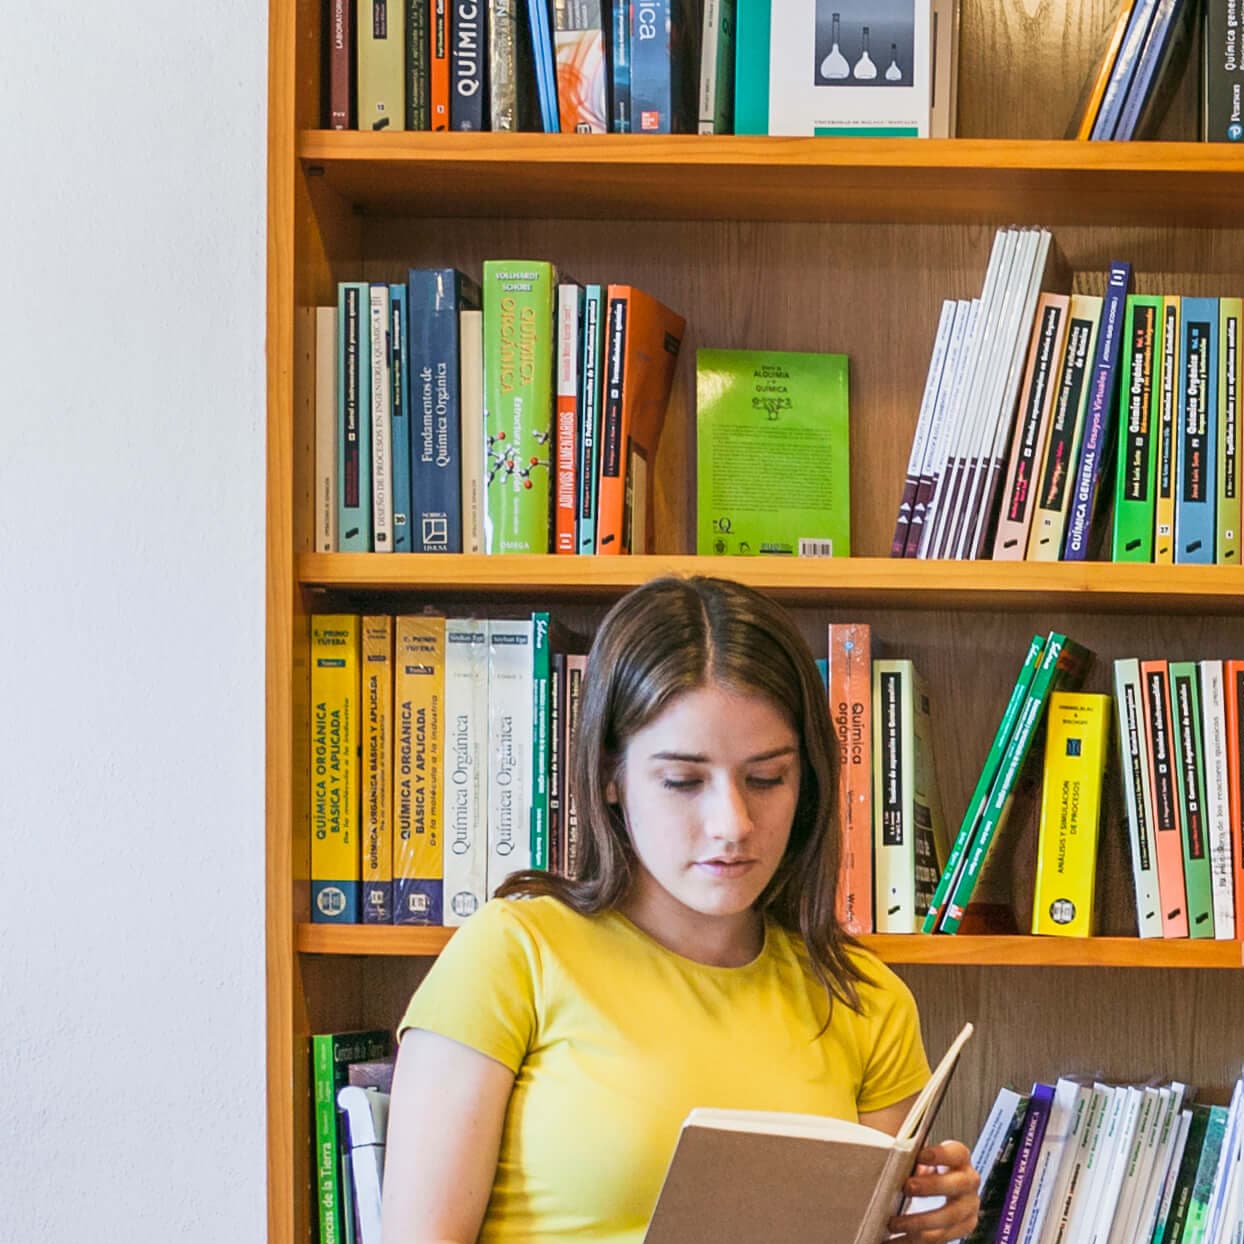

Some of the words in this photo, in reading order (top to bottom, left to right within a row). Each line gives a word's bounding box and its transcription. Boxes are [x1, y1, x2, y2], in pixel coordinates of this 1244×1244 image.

[1231, 84, 1241, 121] Pearson
[372, 316, 383, 358] QUÍMICA
[500, 297, 519, 395] ORGÁNICA
[519, 306, 538, 386] QUÍMICA
[373, 360, 384, 412] INGENIERÍA
[421, 367, 433, 384] de
[434, 362, 449, 415] Orgánica
[1092, 370, 1108, 410] Virtuales
[374, 414, 384, 428] EN
[421, 386, 434, 462] Fundamentos
[434, 416, 449, 467] Química
[560, 412, 574, 470] ALIMENTARIOS
[1086, 412, 1102, 450] Ensayos
[374, 430, 384, 476] PROCESOS
[1133, 450, 1142, 466] Soto
[1133, 467, 1141, 482] Luis
[376, 478, 385, 490] DE
[560, 471, 574, 508] ADITIVOS
[1078, 452, 1096, 501] GENERAL
[1132, 485, 1141, 497] José
[375, 492, 386, 526] DISEÑO
[1070, 503, 1088, 551] QUÍMICA
[369, 675, 378, 723] APLICADA
[314, 702, 327, 778] ORGÁNICA
[330, 709, 341, 771] APLICADA
[368, 734, 378, 772] BÁSICA
[399, 700, 412, 775] ORGÁNICA
[416, 708, 426, 771] APLICADA
[451, 715, 472, 785] Orgánica
[495, 716, 516, 786] Orgánica
[850, 702, 864, 765] Química
[330, 775, 341, 786] Y
[416, 774, 425, 782] Y
[314, 781, 327, 840] QUÍMICA
[329, 789, 341, 833] BÁSICA
[399, 780, 411, 840] QUÍMICA
[413, 785, 425, 834] BÁSICA
[451, 789, 471, 855] Química
[495, 789, 514, 857] Química
[1059, 780, 1070, 830] SIMULACIÓN
[1070, 780, 1080, 824] PROCESOS
[1070, 825, 1078, 835] DE
[1057, 838, 1066, 873] ANÁLISIS
[1021, 1111, 1040, 1147] TÉRMICA
[319, 1142, 333, 1178] Tierra
[1015, 1147, 1030, 1174] SOLAR
[321, 1180, 333, 1190] la
[322, 1193, 334, 1208] de
[1006, 1174, 1025, 1210] ENERGÍA
[1001, 1223, 1011, 1234] DE
[1004, 1211, 1014, 1222] LA
